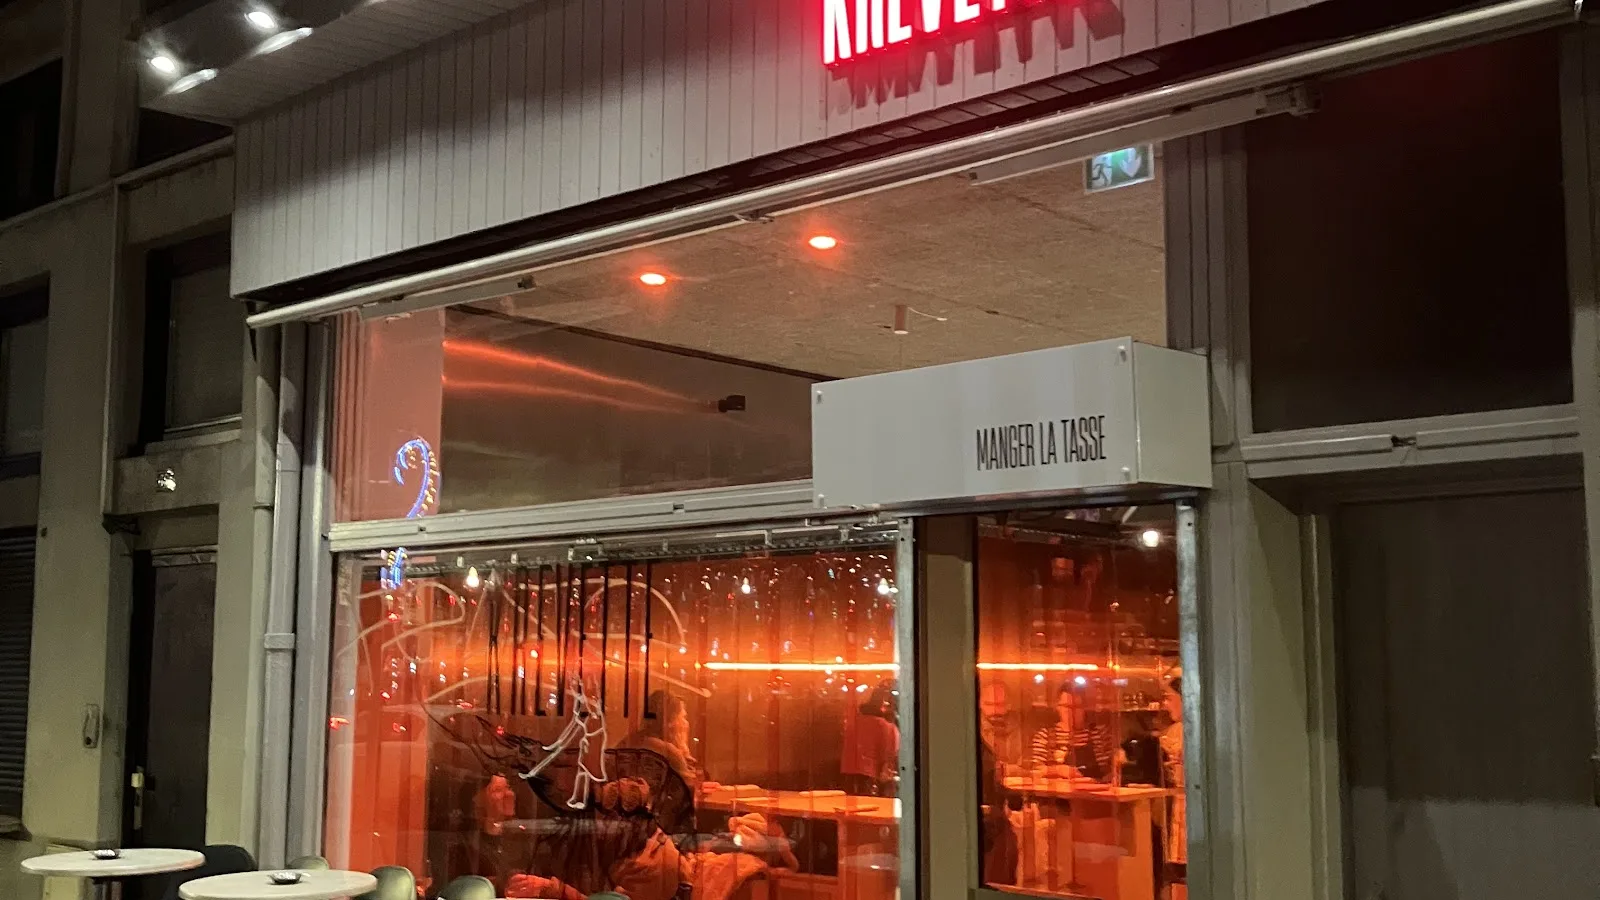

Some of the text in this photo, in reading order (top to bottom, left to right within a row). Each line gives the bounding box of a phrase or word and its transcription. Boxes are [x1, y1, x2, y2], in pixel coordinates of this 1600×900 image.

[976, 415, 1107, 471] MANGER LA TASSE
